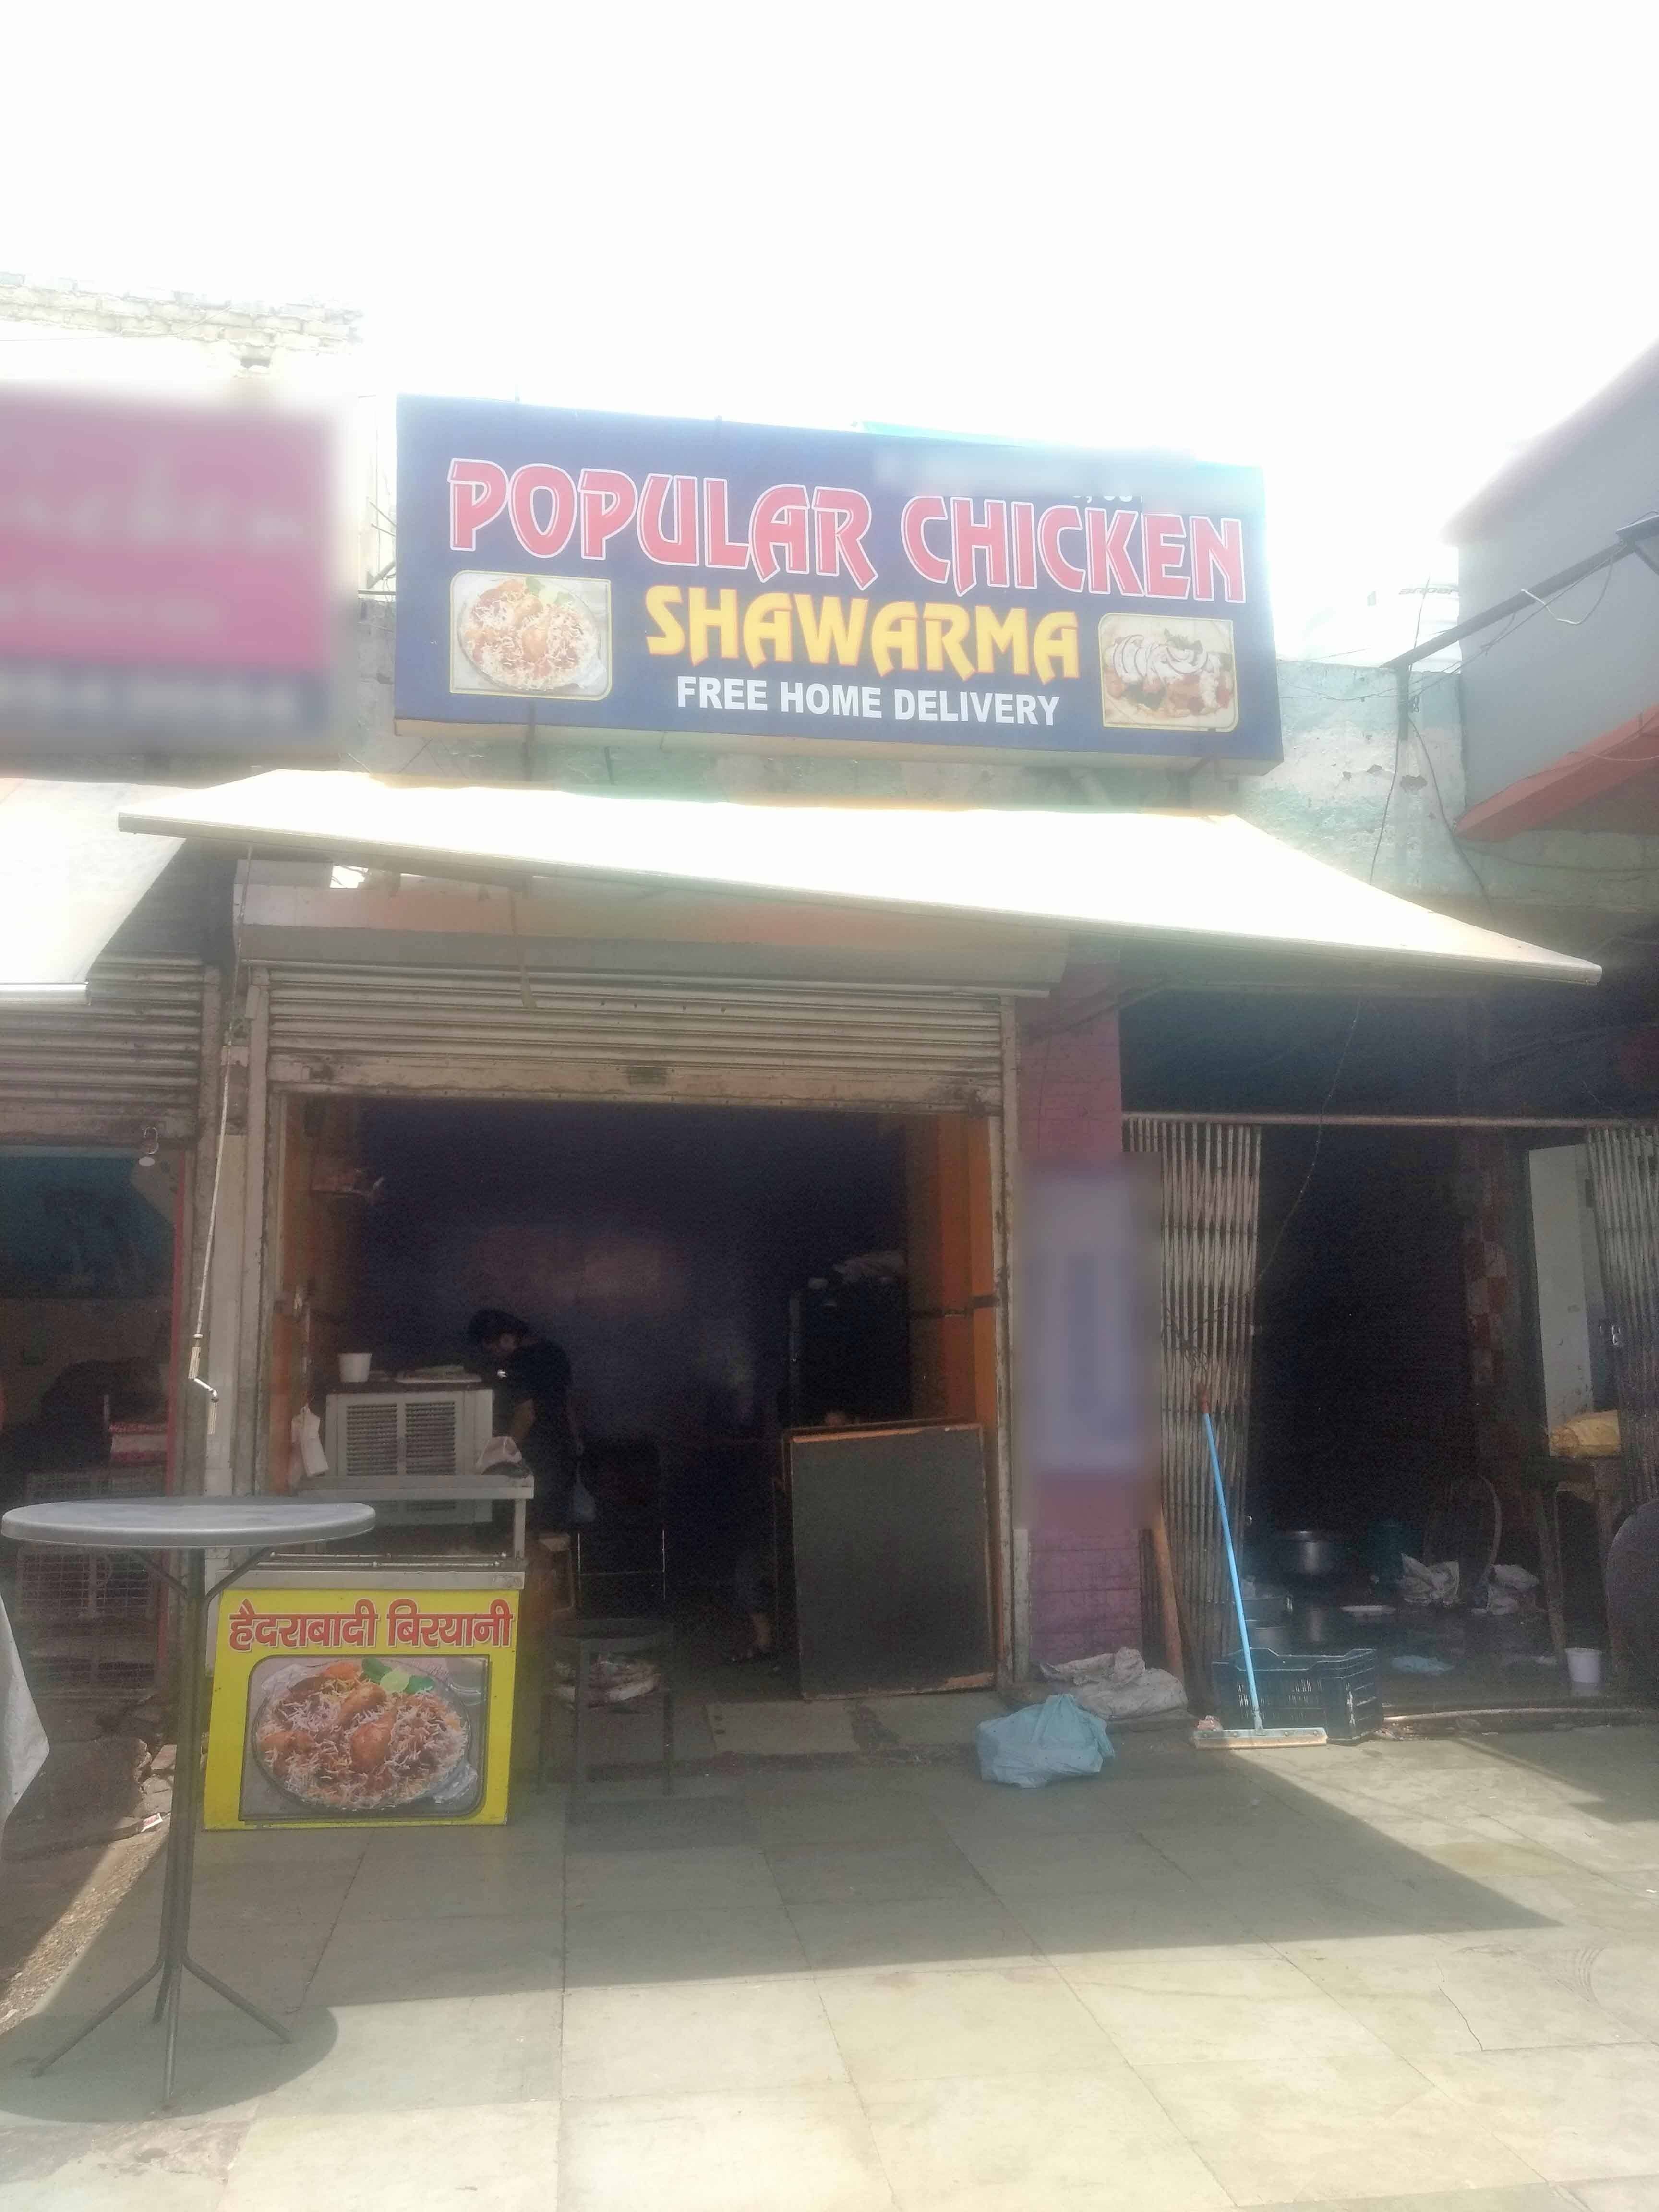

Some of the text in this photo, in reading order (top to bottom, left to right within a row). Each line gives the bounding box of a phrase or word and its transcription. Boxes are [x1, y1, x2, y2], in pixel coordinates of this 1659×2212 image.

[448, 458, 1246, 603] POPULAR CHICKEN
[645, 585, 1079, 684] SHAWARMA
[677, 676, 1060, 726] FREE HOME DELIVERY
[229, 1598, 514, 1652] हैदराबादी बिरयानी
